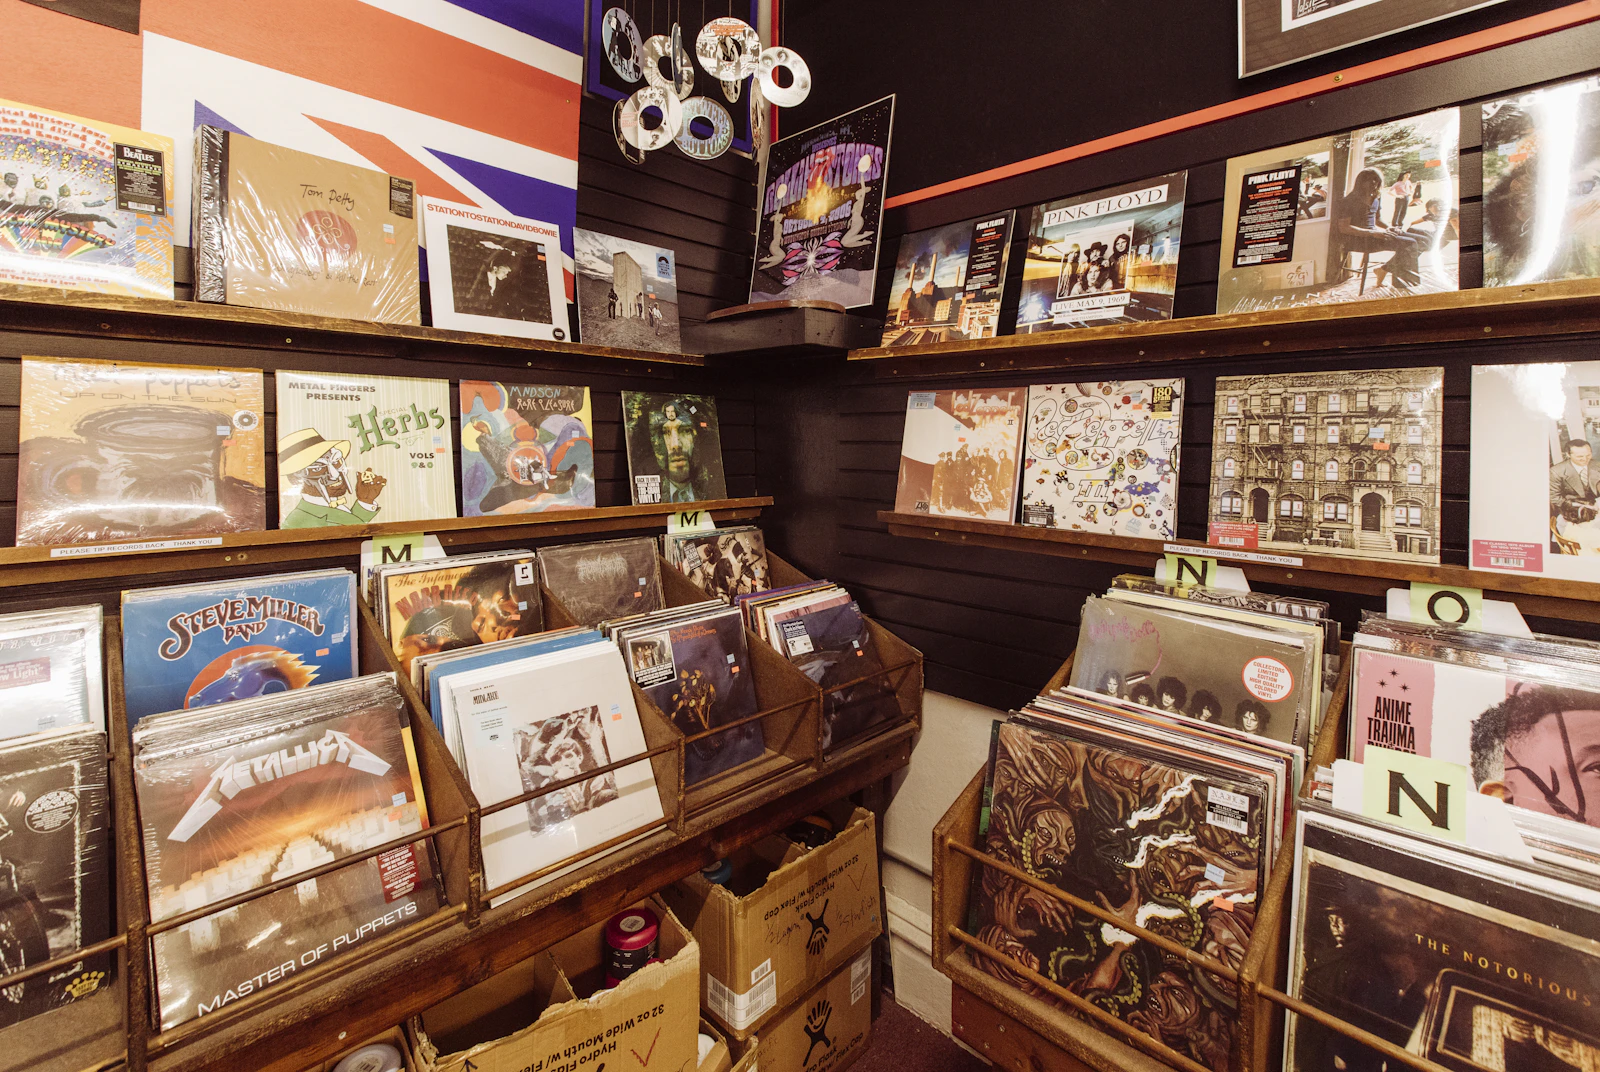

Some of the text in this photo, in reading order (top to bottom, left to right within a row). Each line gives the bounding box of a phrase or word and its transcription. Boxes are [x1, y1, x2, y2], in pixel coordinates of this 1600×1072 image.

[123, 146, 155, 162] BEATLES
[1248, 168, 1296, 186] PINK FLOYD
[300, 183, 356, 212] Tom Petty
[1046, 187, 1164, 226] PINK FLOYD
[44, 217, 117, 248] MYSTERY
[1055, 302, 1075, 311] LIVE
[1077, 299, 1097, 308] MAY
[1108, 296, 1125, 304] 1969
[288, 382, 376, 393] METAL FINGERS
[510, 385, 561, 398] MNDSGN
[1153, 386, 1172, 397] 180
[142, 394, 184, 402] THE
[190, 396, 237, 404] SUN
[306, 393, 361, 402] PRESENTS
[516, 398, 575, 412] RARE PLEASURE
[1153, 396, 1171, 404] gram
[378, 407, 408, 416] SPECIAL
[345, 402, 445, 455] Herbs
[679, 511, 699, 527] M
[59, 548, 92, 556] PLEASE
[106, 543, 144, 552] RECORDS
[145, 541, 165, 549] BACK
[381, 543, 412, 564] M
[1202, 549, 1231, 558] RECORDS
[1176, 557, 1208, 586] N
[395, 574, 416, 588] The
[1427, 590, 1470, 624] O
[158, 595, 326, 662] STEVE MILLER
[222, 620, 268, 645] BAND
[1253, 661, 1286, 674] COLLECTORS
[1257, 667, 1279, 677] LIMITED
[1249, 676, 1285, 690] HIGH QUALITY
[1257, 673, 1278, 683] EDITION
[1254, 684, 1278, 694] COLORED
[1257, 690, 1273, 699] VINYL
[472, 690, 500, 705] MIDLAKE
[1374, 696, 1413, 726] ANIME
[1367, 716, 1416, 751] TRAUMA
[167, 728, 392, 843] METALLICA
[1386, 769, 1451, 831] N
[828, 865, 844, 879] Wide
[806, 876, 828, 895] Mouth
[780, 896, 796, 909] Flex
[795, 882, 835, 913] Hydro Flask
[764, 907, 780, 921] Cap
[197, 901, 418, 1017] MASTER OF PUPPETS
[1414, 933, 1592, 1008] THE NOTORIOUS
[636, 1012, 650, 1023] oz
[651, 1003, 665, 1018] 32
[605, 1018, 635, 1038] Wide
[564, 1034, 604, 1059] Mouth
[579, 1040, 617, 1064] Hydro
[545, 1052, 561, 1068] w/
[818, 1045, 837, 1067] Flask
